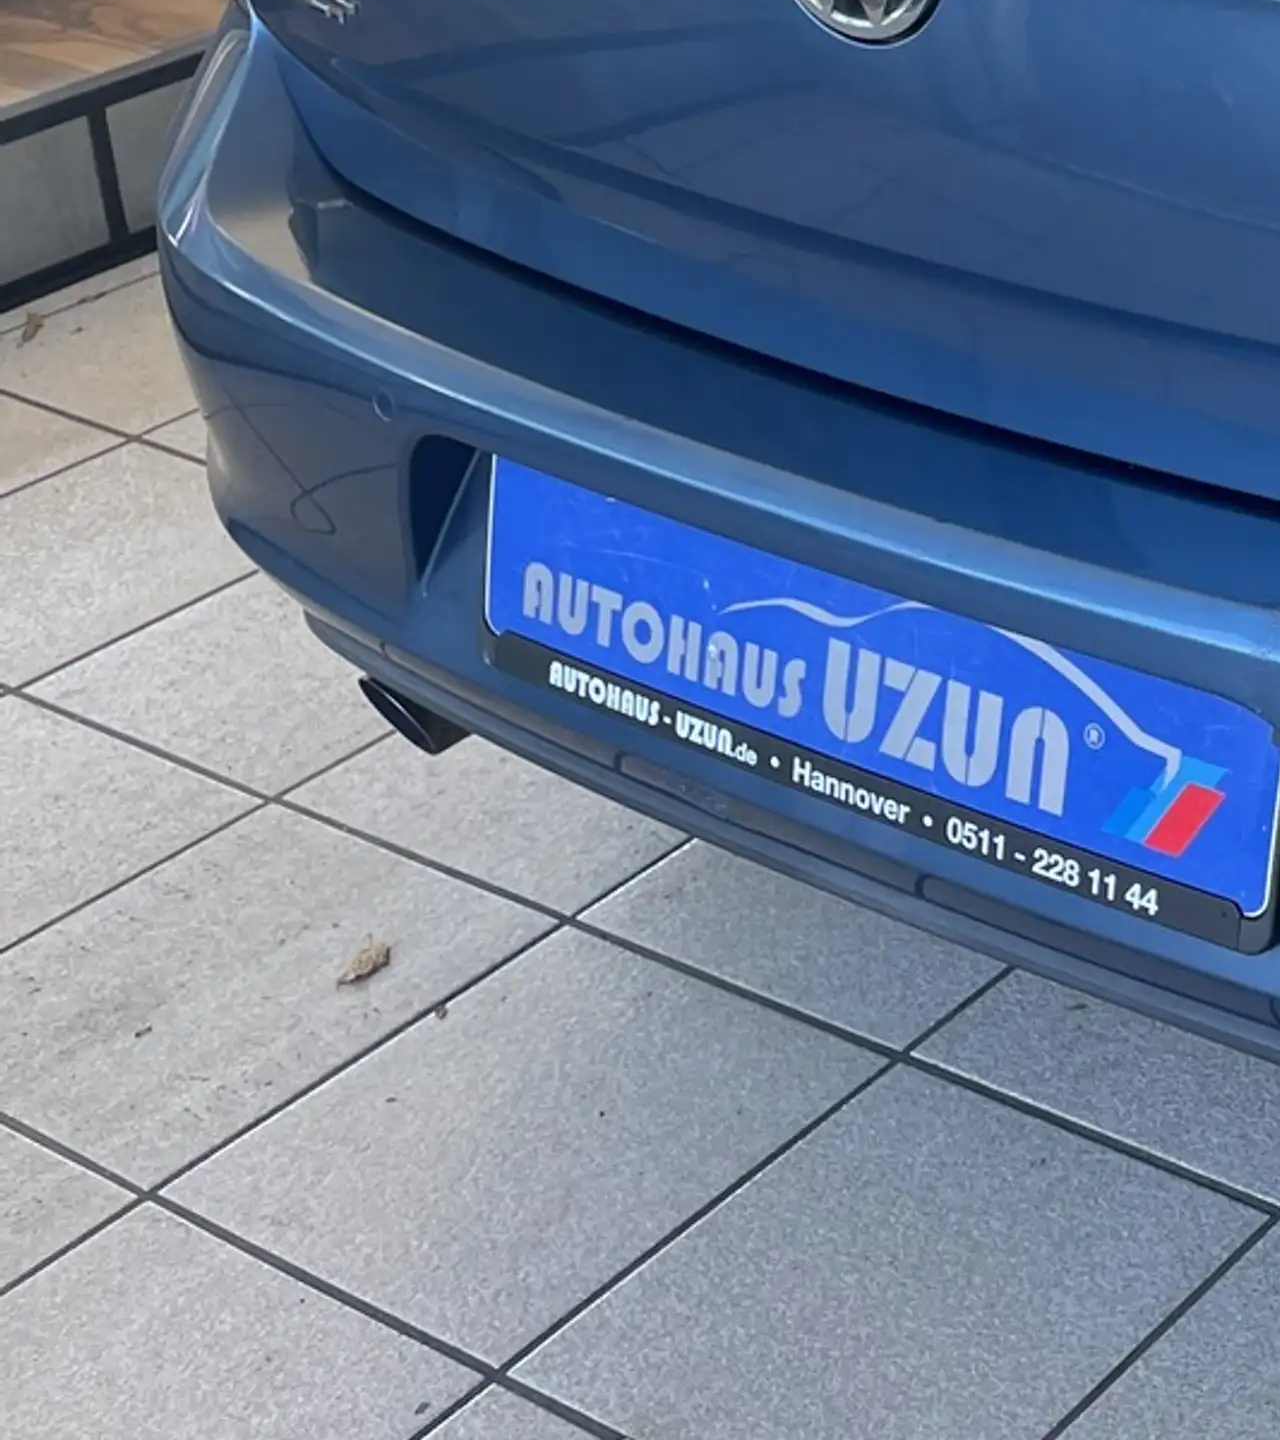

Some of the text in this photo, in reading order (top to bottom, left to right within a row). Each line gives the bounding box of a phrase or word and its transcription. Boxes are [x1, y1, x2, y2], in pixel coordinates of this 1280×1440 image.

[522, 560, 807, 718] AUTOHAUS
[550, 660, 660, 727] AUTOHAUS
[792, 756, 912, 824] Hannover
[946, 815, 1005, 860] 0511
[1031, 846, 1081, 888] 228
[1087, 868, 1117, 902] 11
[1124, 882, 1159, 916] 44
